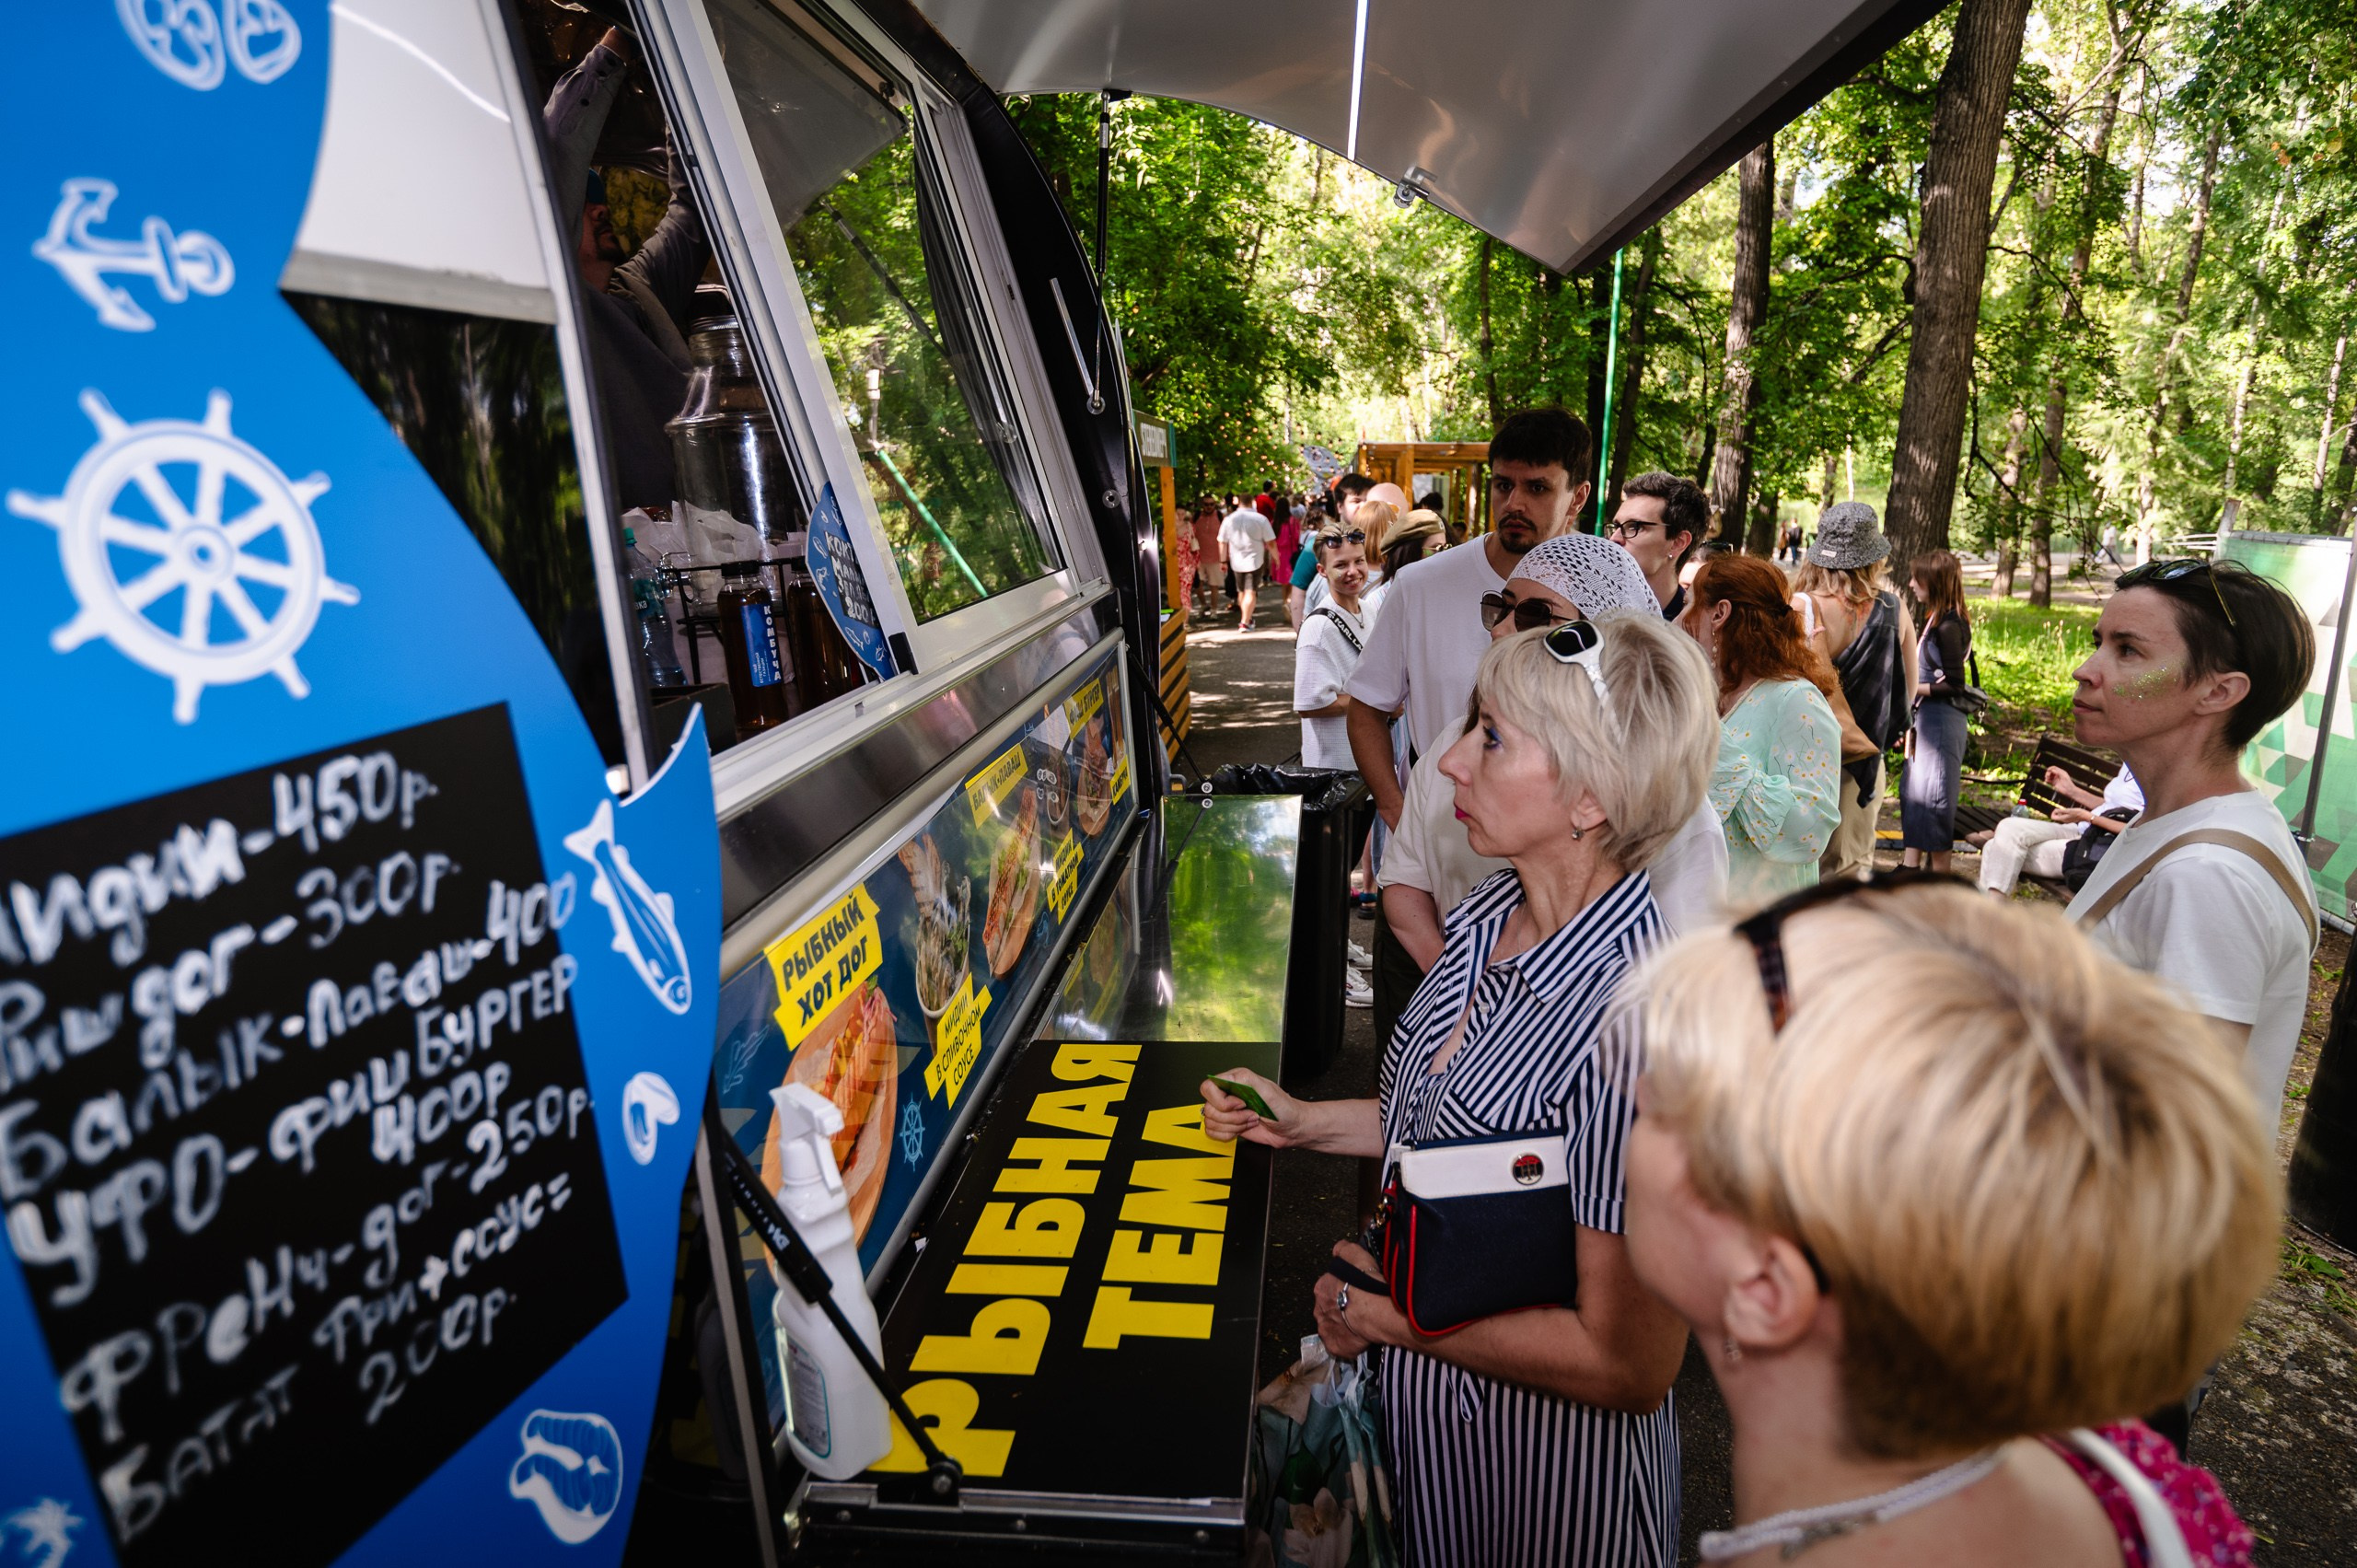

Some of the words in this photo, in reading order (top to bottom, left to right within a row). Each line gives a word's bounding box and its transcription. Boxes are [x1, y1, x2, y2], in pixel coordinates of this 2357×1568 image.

[763, 605, 782, 681] КОМБУЧА
[1334, 617, 1353, 640] KARL
[1083, 683, 1100, 713] БУРГЕР
[1051, 887, 1056, 903] В
[1056, 852, 1078, 895] ТОМАТНОМ
[1062, 881, 1074, 910] СОУСЕ
[783, 891, 865, 993] РЫБНЫЙ
[796, 970, 832, 1028] ХОТ
[837, 935, 867, 993] ДОГ
[935, 1063, 942, 1083] В
[942, 1005, 981, 1072] СЛИВОЧНОМ
[944, 992, 969, 1039] МИДИИ
[953, 1043, 974, 1086] СОУСЕ
[1083, 1103, 1237, 1350] ТЕМА
[868, 1044, 1142, 1477] РЫБНАЯ
